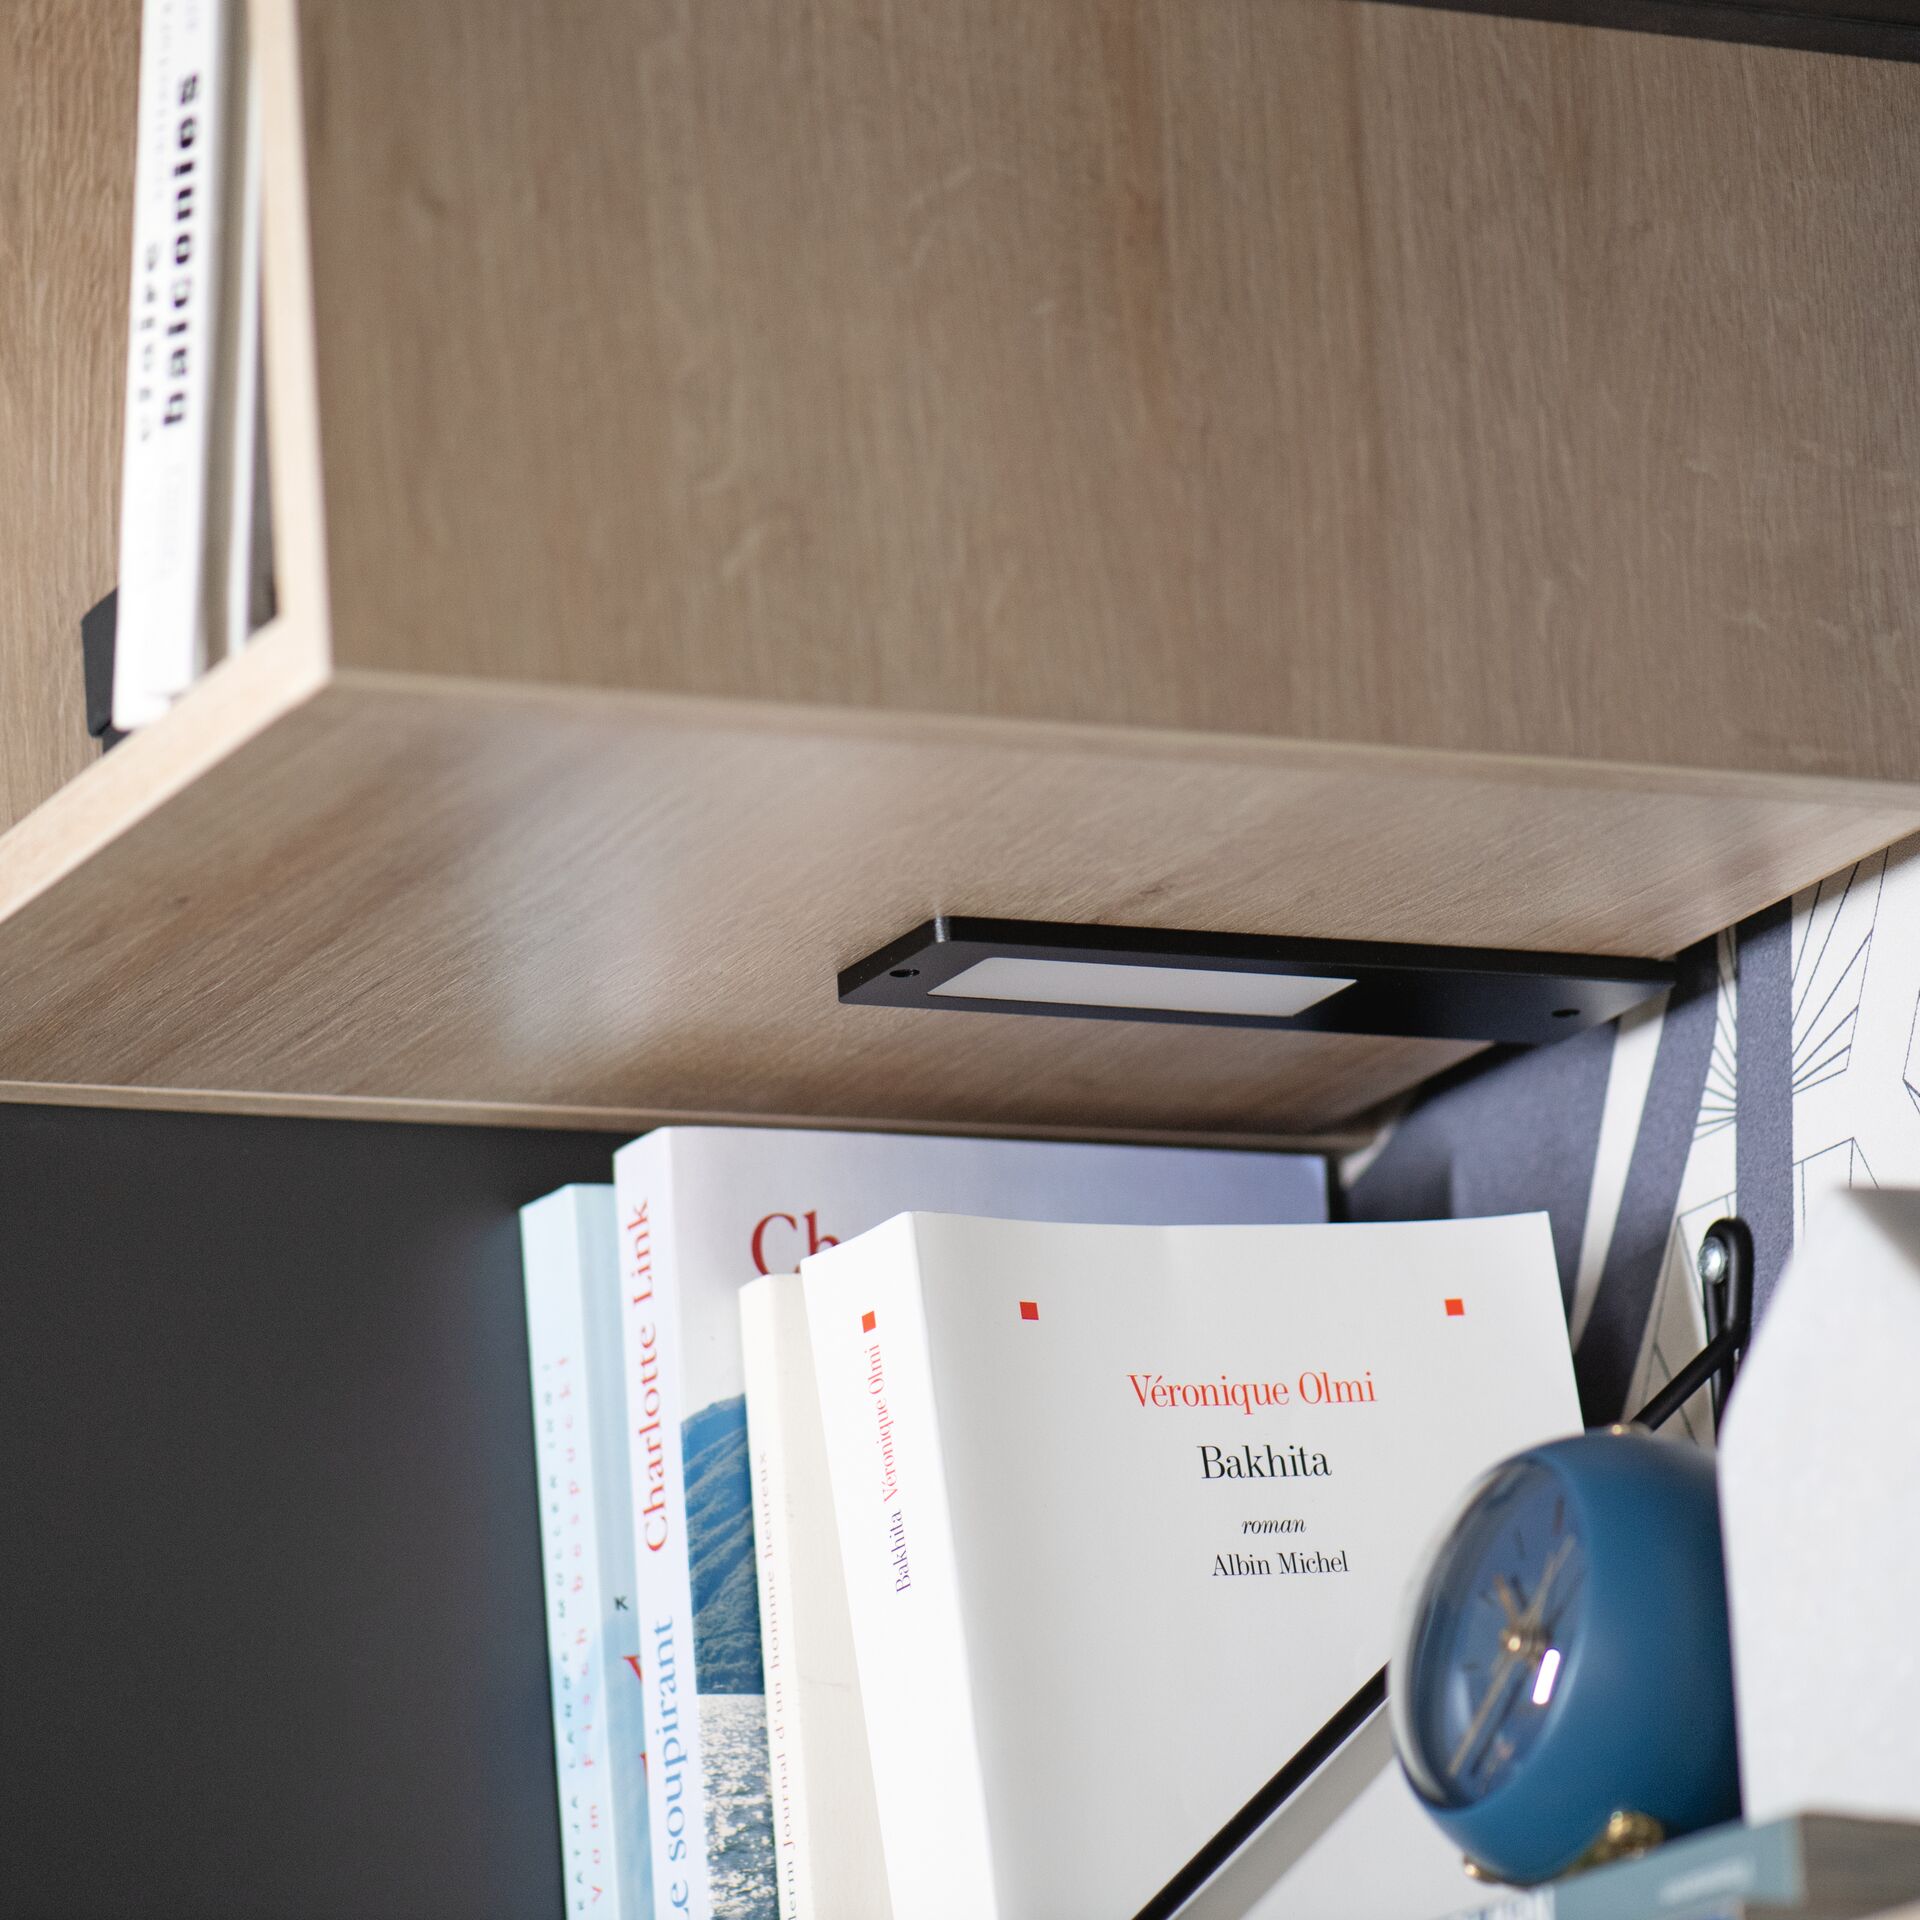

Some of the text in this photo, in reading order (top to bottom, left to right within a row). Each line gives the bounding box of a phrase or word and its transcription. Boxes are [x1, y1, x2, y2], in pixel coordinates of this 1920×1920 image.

[163, 74, 199, 426] balconies
[627, 1197, 668, 1551] Charlotte Link
[1126, 1371, 1378, 1416] Véronique Olmi
[557, 1356, 584, 1593] bespuckt
[759, 1452, 774, 1559] heureux
[864, 1343, 912, 1594] Bakhita Véronique Olmi
[1197, 1444, 1332, 1480] Bakhita
[1212, 1550, 1351, 1577] Albin Michel
[1242, 1519, 1306, 1535] roman
[768, 1570, 781, 1669] homme
[575, 1625, 595, 1769] Fisch
[654, 1614, 688, 1862] soupirant
[772, 1681, 785, 1740] d'un
[776, 1753, 796, 1851] Journal
